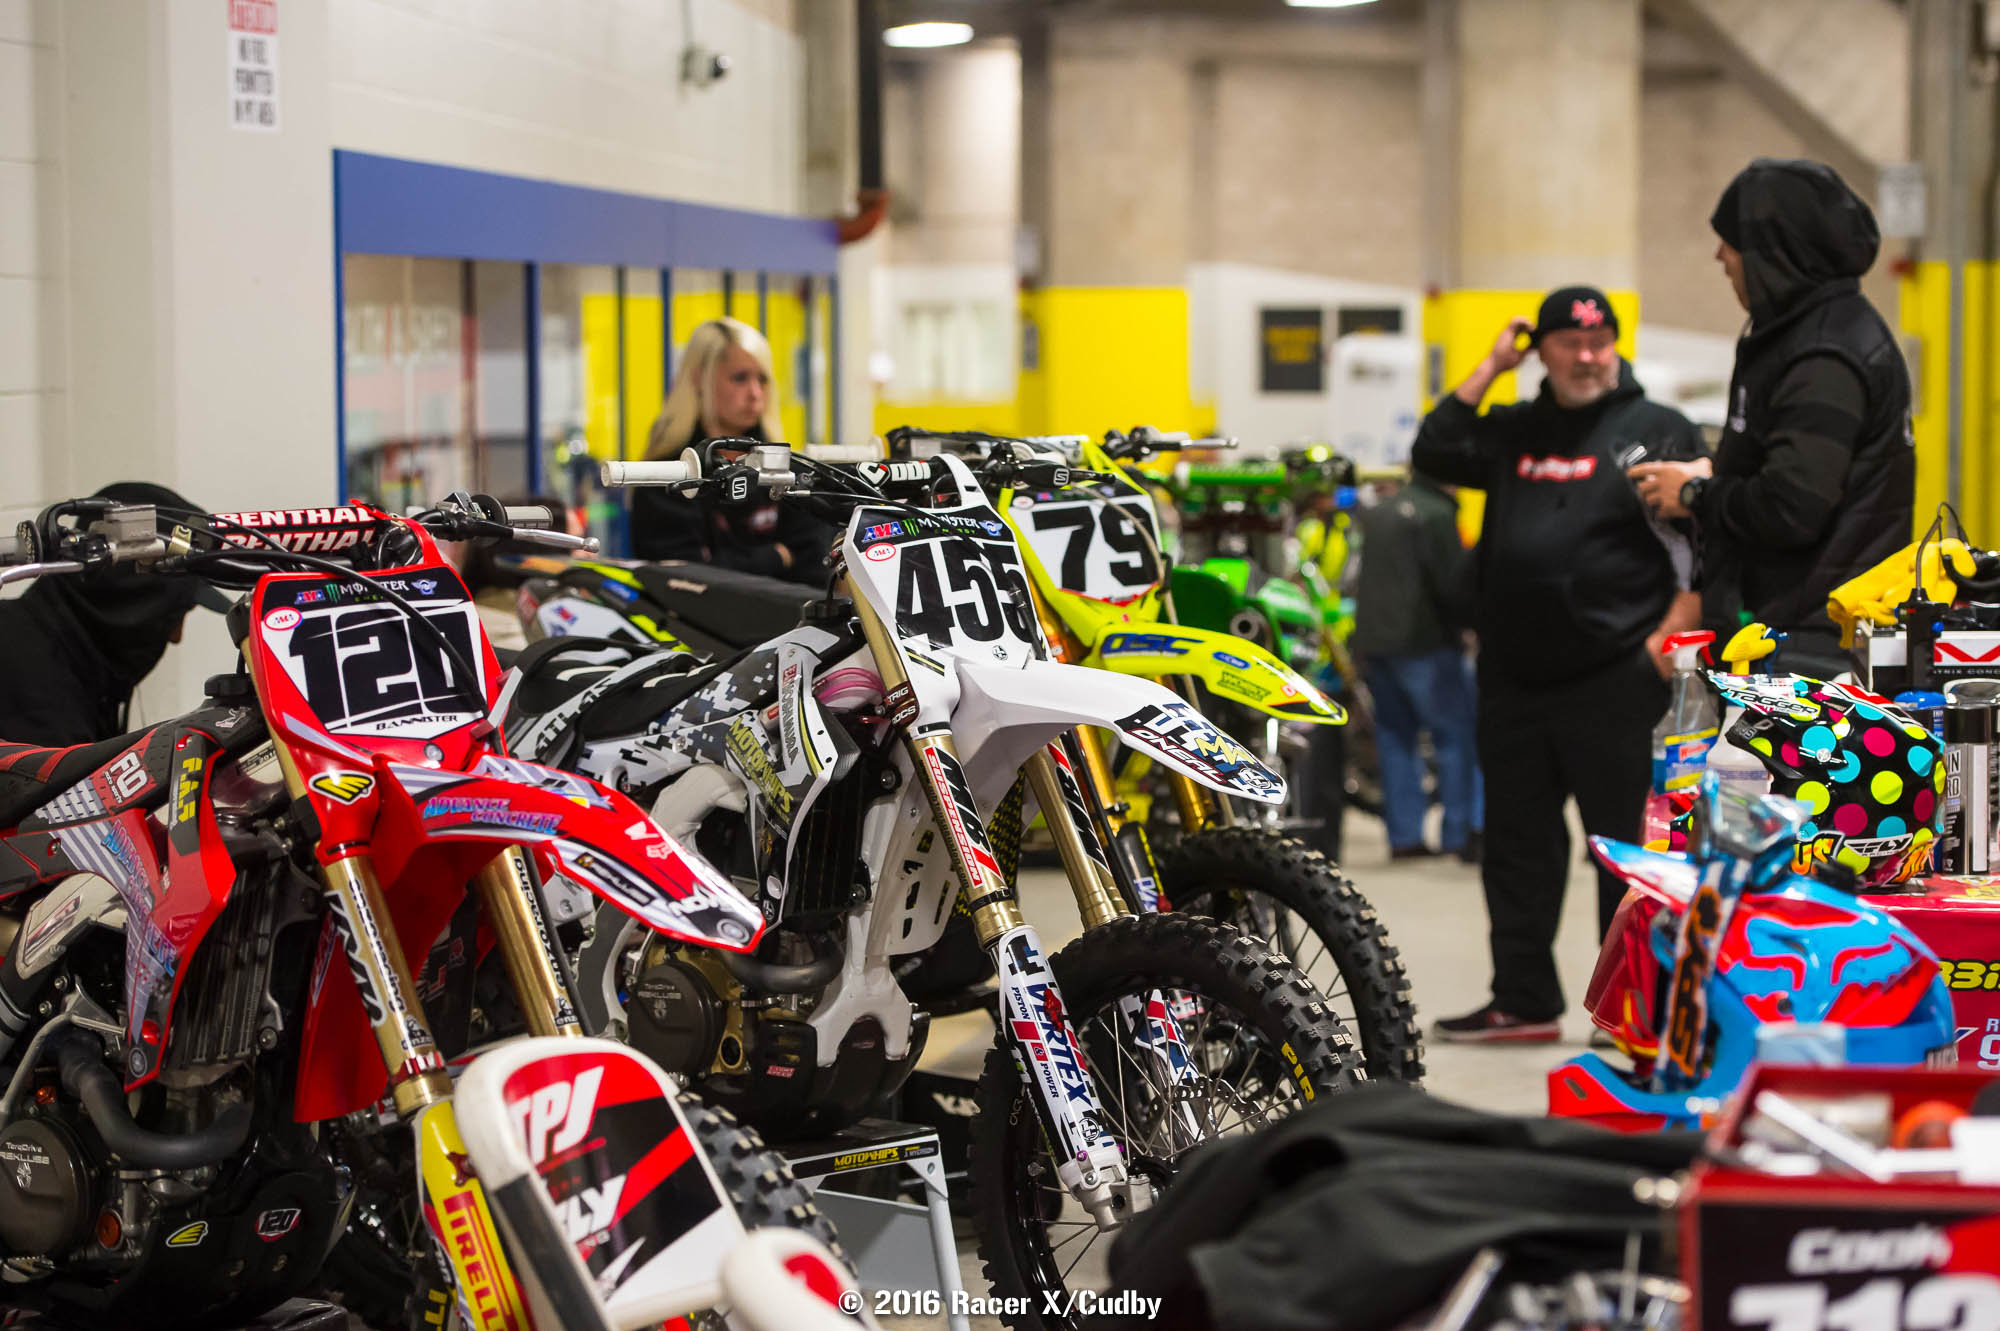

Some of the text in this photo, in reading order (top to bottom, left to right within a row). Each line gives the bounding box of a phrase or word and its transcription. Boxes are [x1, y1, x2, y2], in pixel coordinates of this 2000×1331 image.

[215, 507, 376, 528] RENTHAL
[864, 521, 904, 542] AMA
[1031, 505, 1160, 592] 79
[895, 538, 1034, 651] 455
[288, 606, 489, 726] 120
[375, 714, 459, 732] BANNISTER
[423, 796, 511, 820] ADVANCE
[471, 809, 564, 835] CONCRETE
[927, 753, 983, 884] SUSPENSION
[1011, 986, 1031, 1020] PISTON
[1040, 1062, 1059, 1098] POWER
[1027, 983, 1097, 1114] VERTEX
[834, 1147, 899, 1168] MOTOWHIPS
